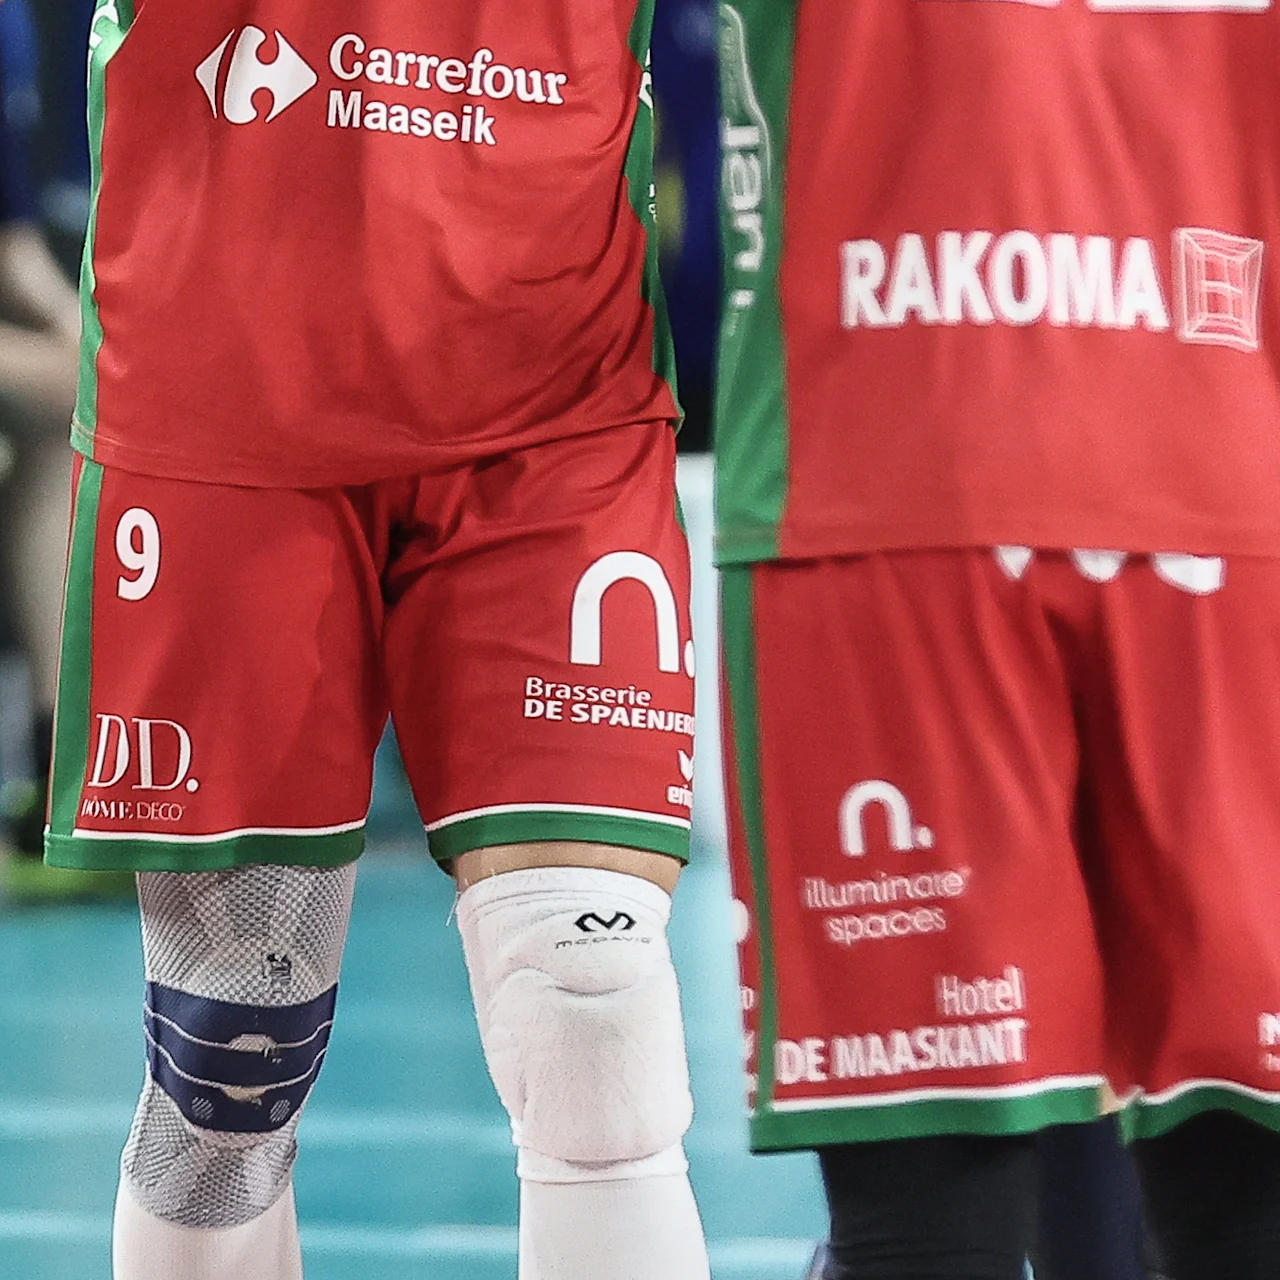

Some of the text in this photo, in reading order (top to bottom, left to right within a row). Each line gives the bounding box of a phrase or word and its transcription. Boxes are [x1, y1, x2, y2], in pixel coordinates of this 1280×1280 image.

[329, 34, 567, 106] Carrefour
[327, 90, 497, 146] Maaseik
[840, 230, 1171, 331] RAKOMA
[115, 507, 161, 601] 9
[523, 698, 695, 736] DE SPAENJER
[525, 676, 652, 707] Brasserie
[136, 801, 186, 821] DECO
[826, 907, 947, 946] spaces
[938, 965, 1024, 1017] Hotel
[777, 1037, 828, 1084] DE
[830, 1018, 1029, 1079] MAASKANT
